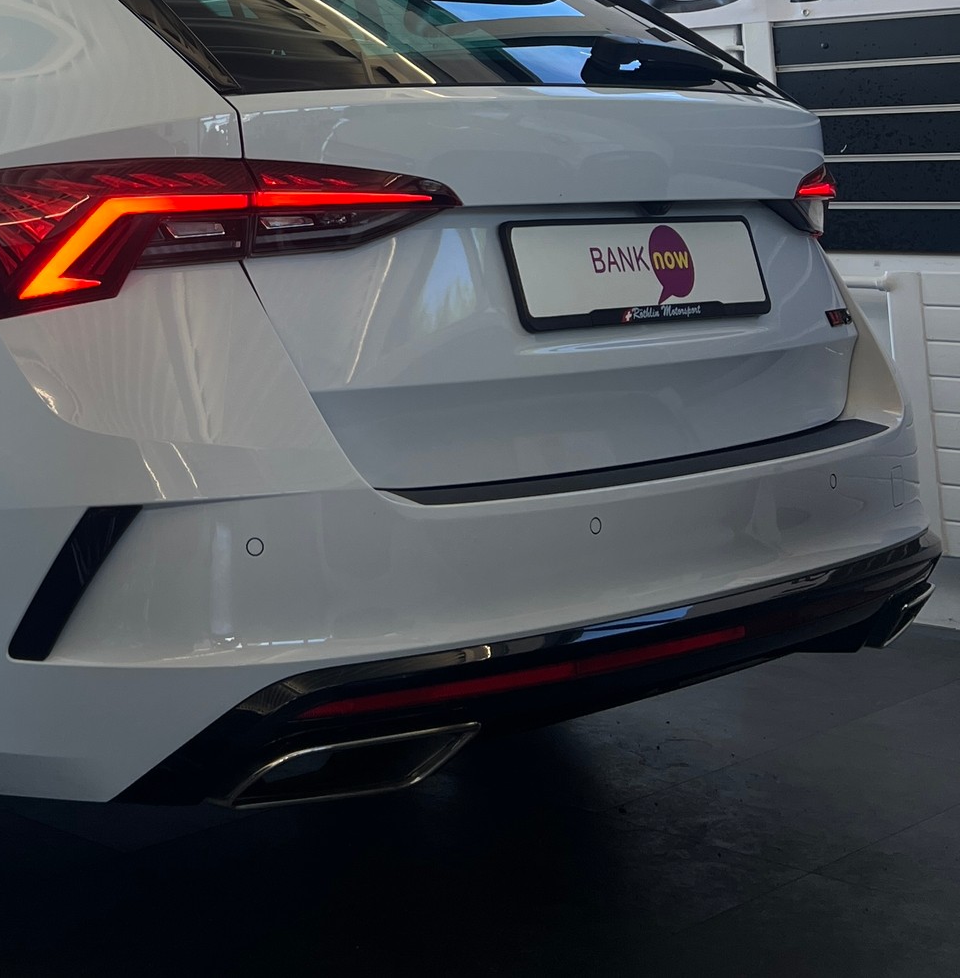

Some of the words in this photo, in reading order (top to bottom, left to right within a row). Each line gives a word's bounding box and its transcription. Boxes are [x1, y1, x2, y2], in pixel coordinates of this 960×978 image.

[589, 246, 650, 273] BANK
[652, 251, 688, 270] now
[661, 305, 701, 318] Motorsport
